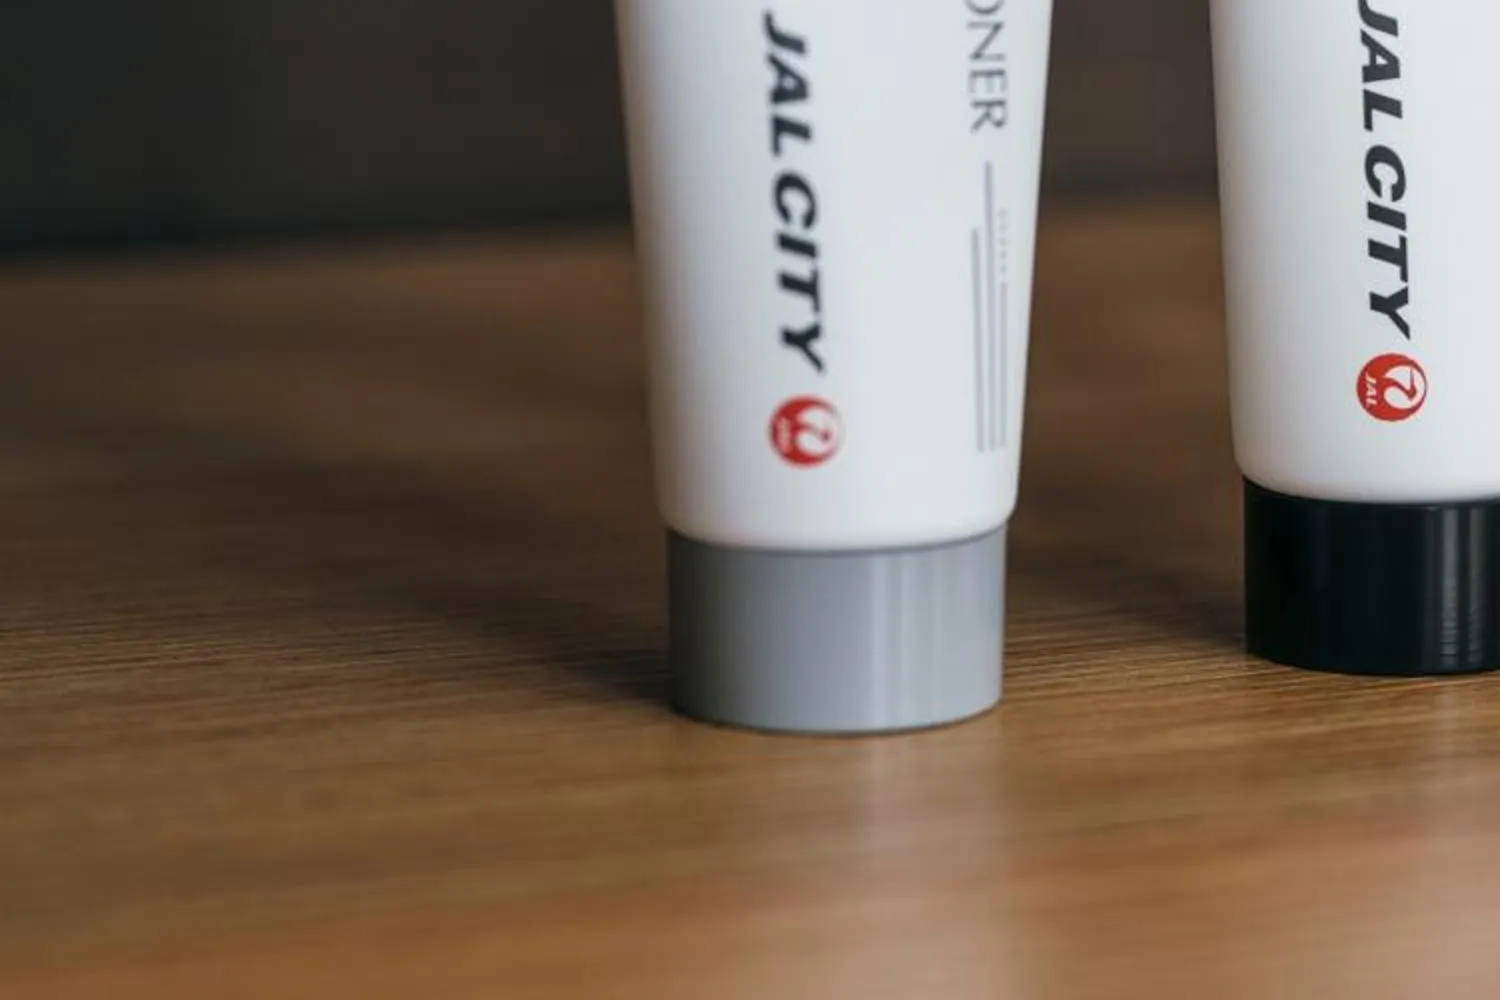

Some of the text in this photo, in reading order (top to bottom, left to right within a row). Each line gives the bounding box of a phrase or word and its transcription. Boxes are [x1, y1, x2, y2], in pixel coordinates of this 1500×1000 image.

[763, 10, 813, 157] JAL
[773, 171, 825, 375] CITY
[1364, 144, 1411, 340] CITY
[1365, 371, 1377, 409] JAL
